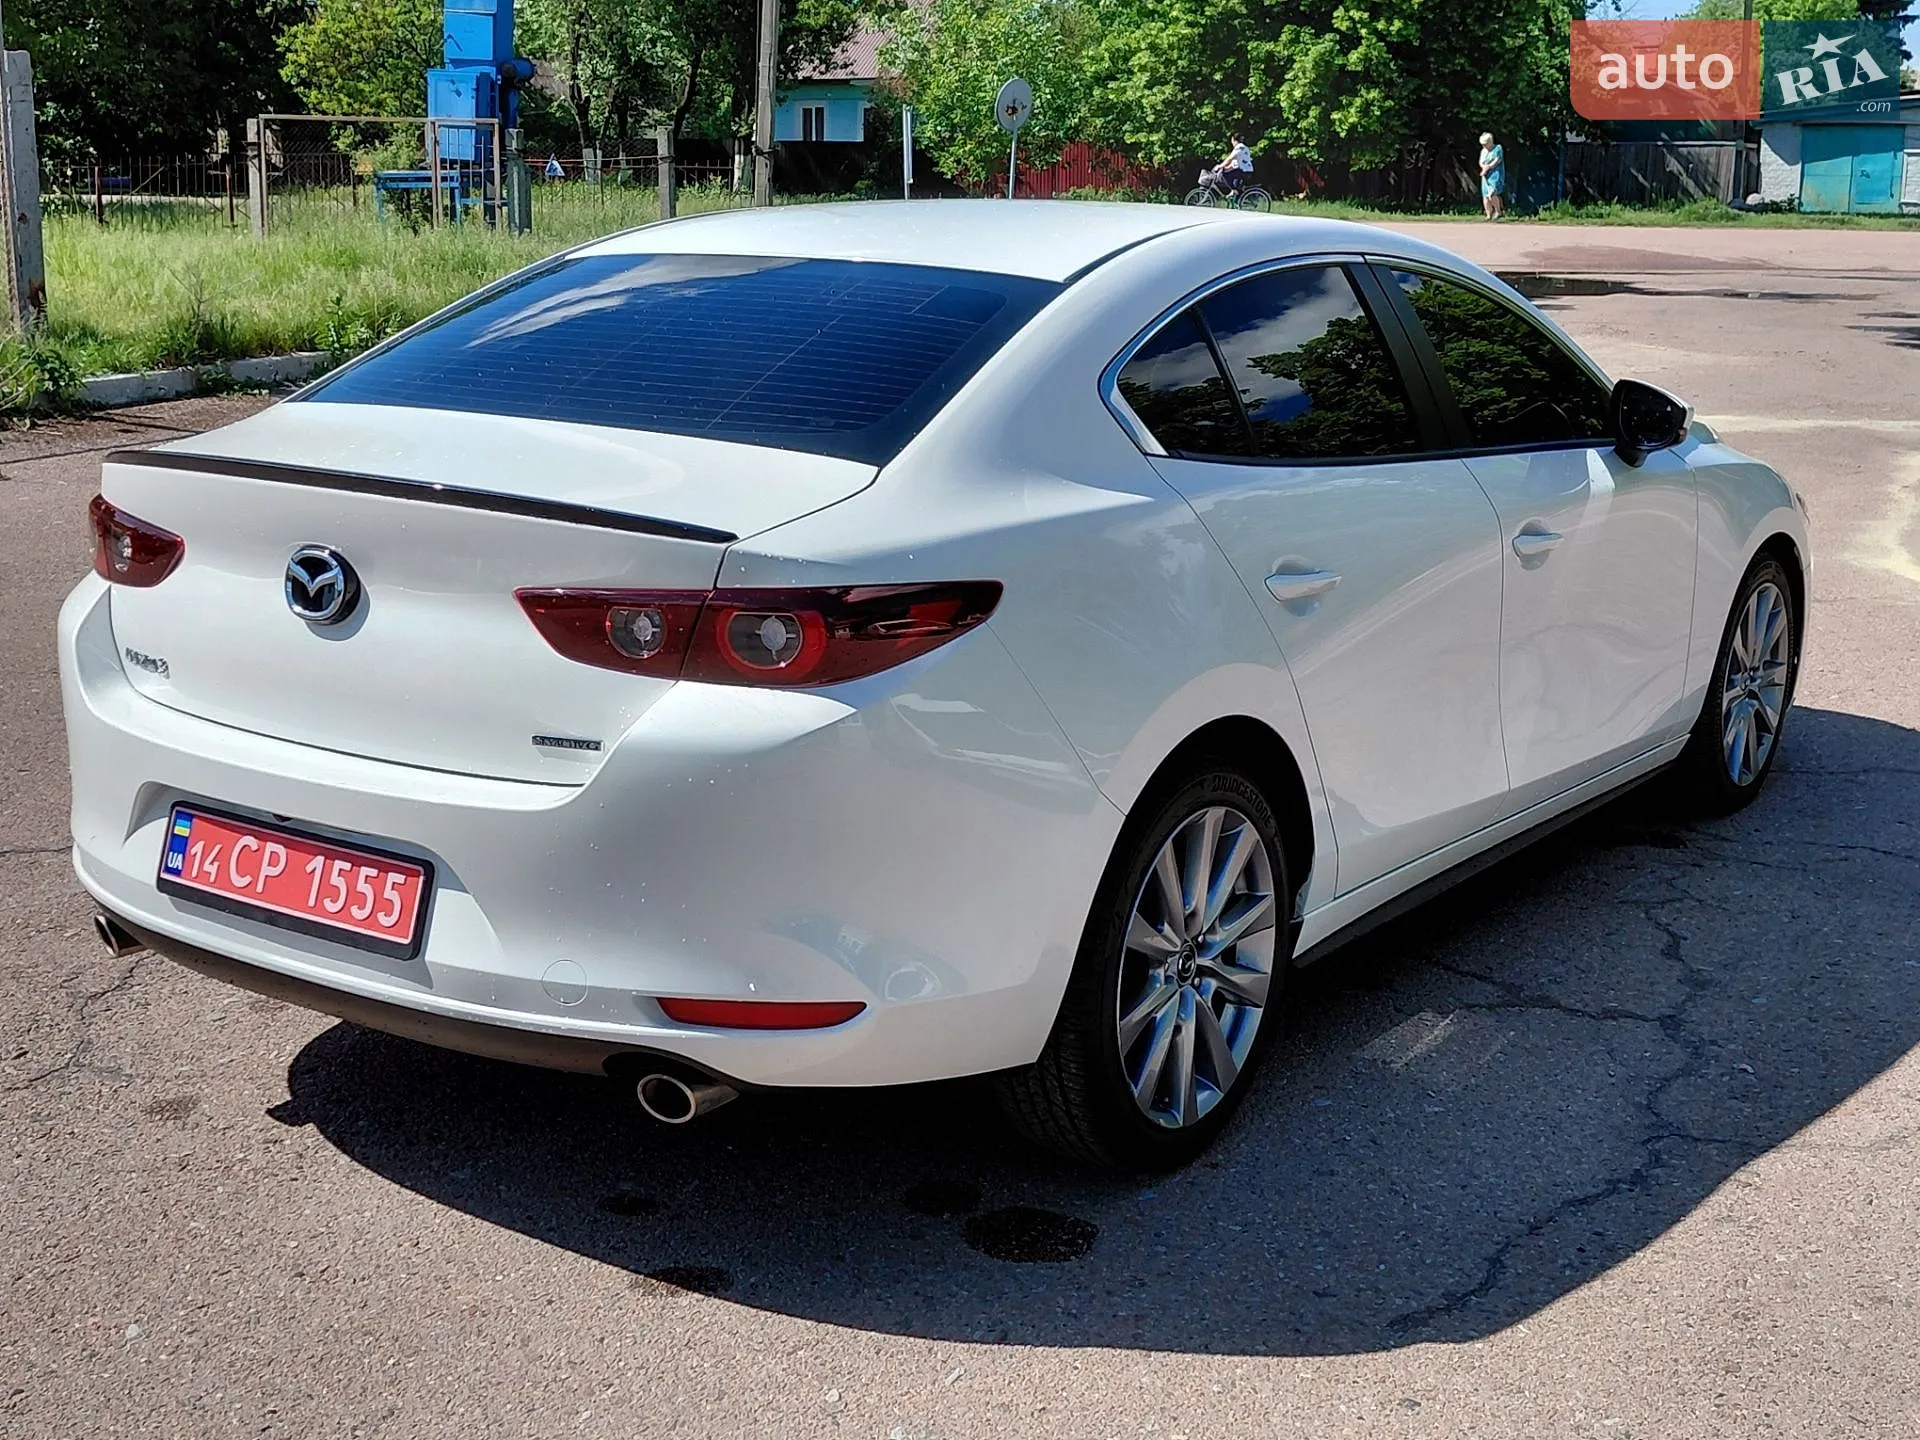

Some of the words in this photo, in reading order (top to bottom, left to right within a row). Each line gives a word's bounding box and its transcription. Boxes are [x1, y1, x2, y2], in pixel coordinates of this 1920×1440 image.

[168, 852, 183, 871] UA
[190, 840, 223, 884] 14
[229, 835, 288, 893] CP
[305, 855, 408, 928] 1555
